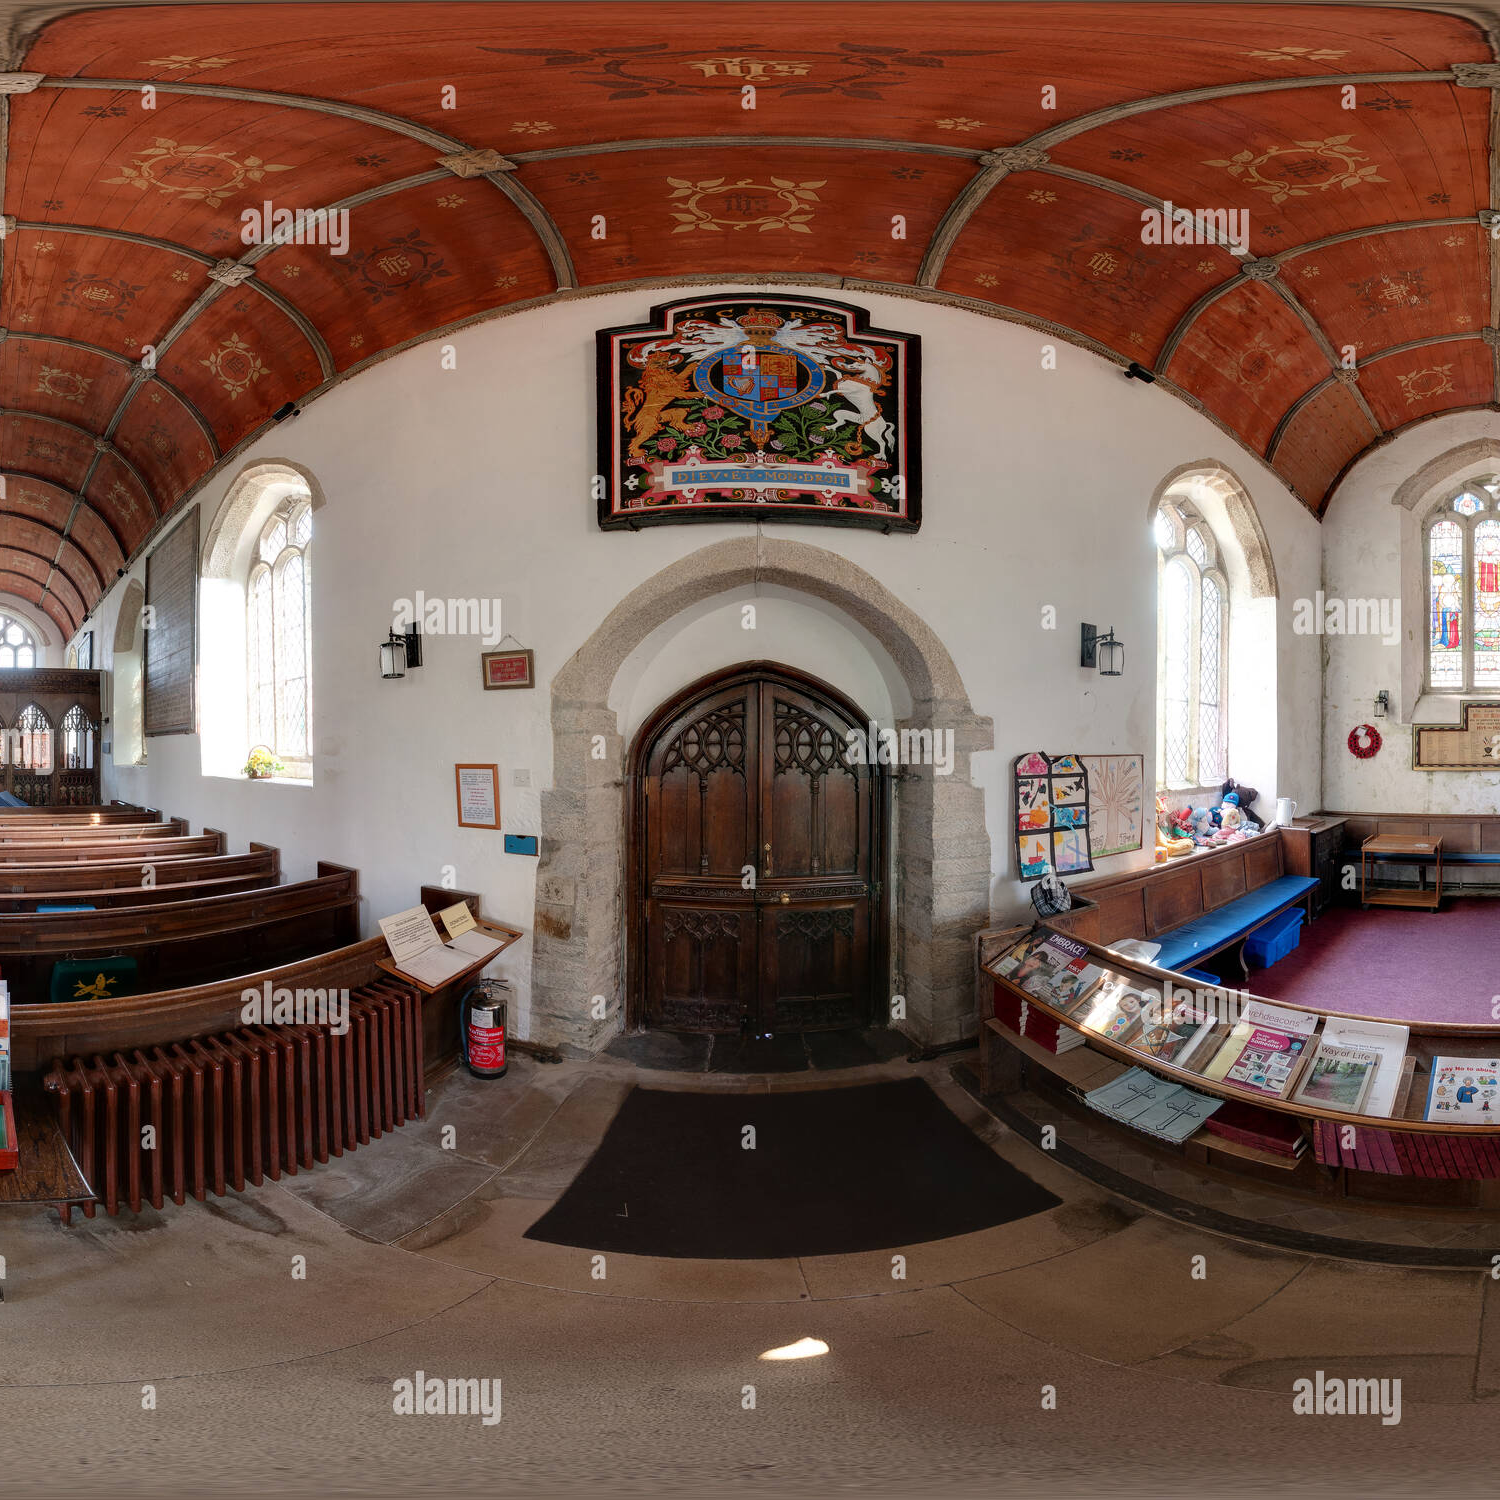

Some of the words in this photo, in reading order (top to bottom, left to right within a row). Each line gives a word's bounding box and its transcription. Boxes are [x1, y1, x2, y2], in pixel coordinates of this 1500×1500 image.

[716, 308, 734, 318] C
[790, 311, 807, 320] R
[731, 470, 754, 481] ET
[764, 471, 798, 482] MON
[803, 472, 847, 485] DROIT
[1049, 934, 1085, 956] EMBRACE
[1321, 1045, 1340, 1058] Way
[1340, 1050, 1350, 1058] of
[1352, 1051, 1371, 1061] Life
